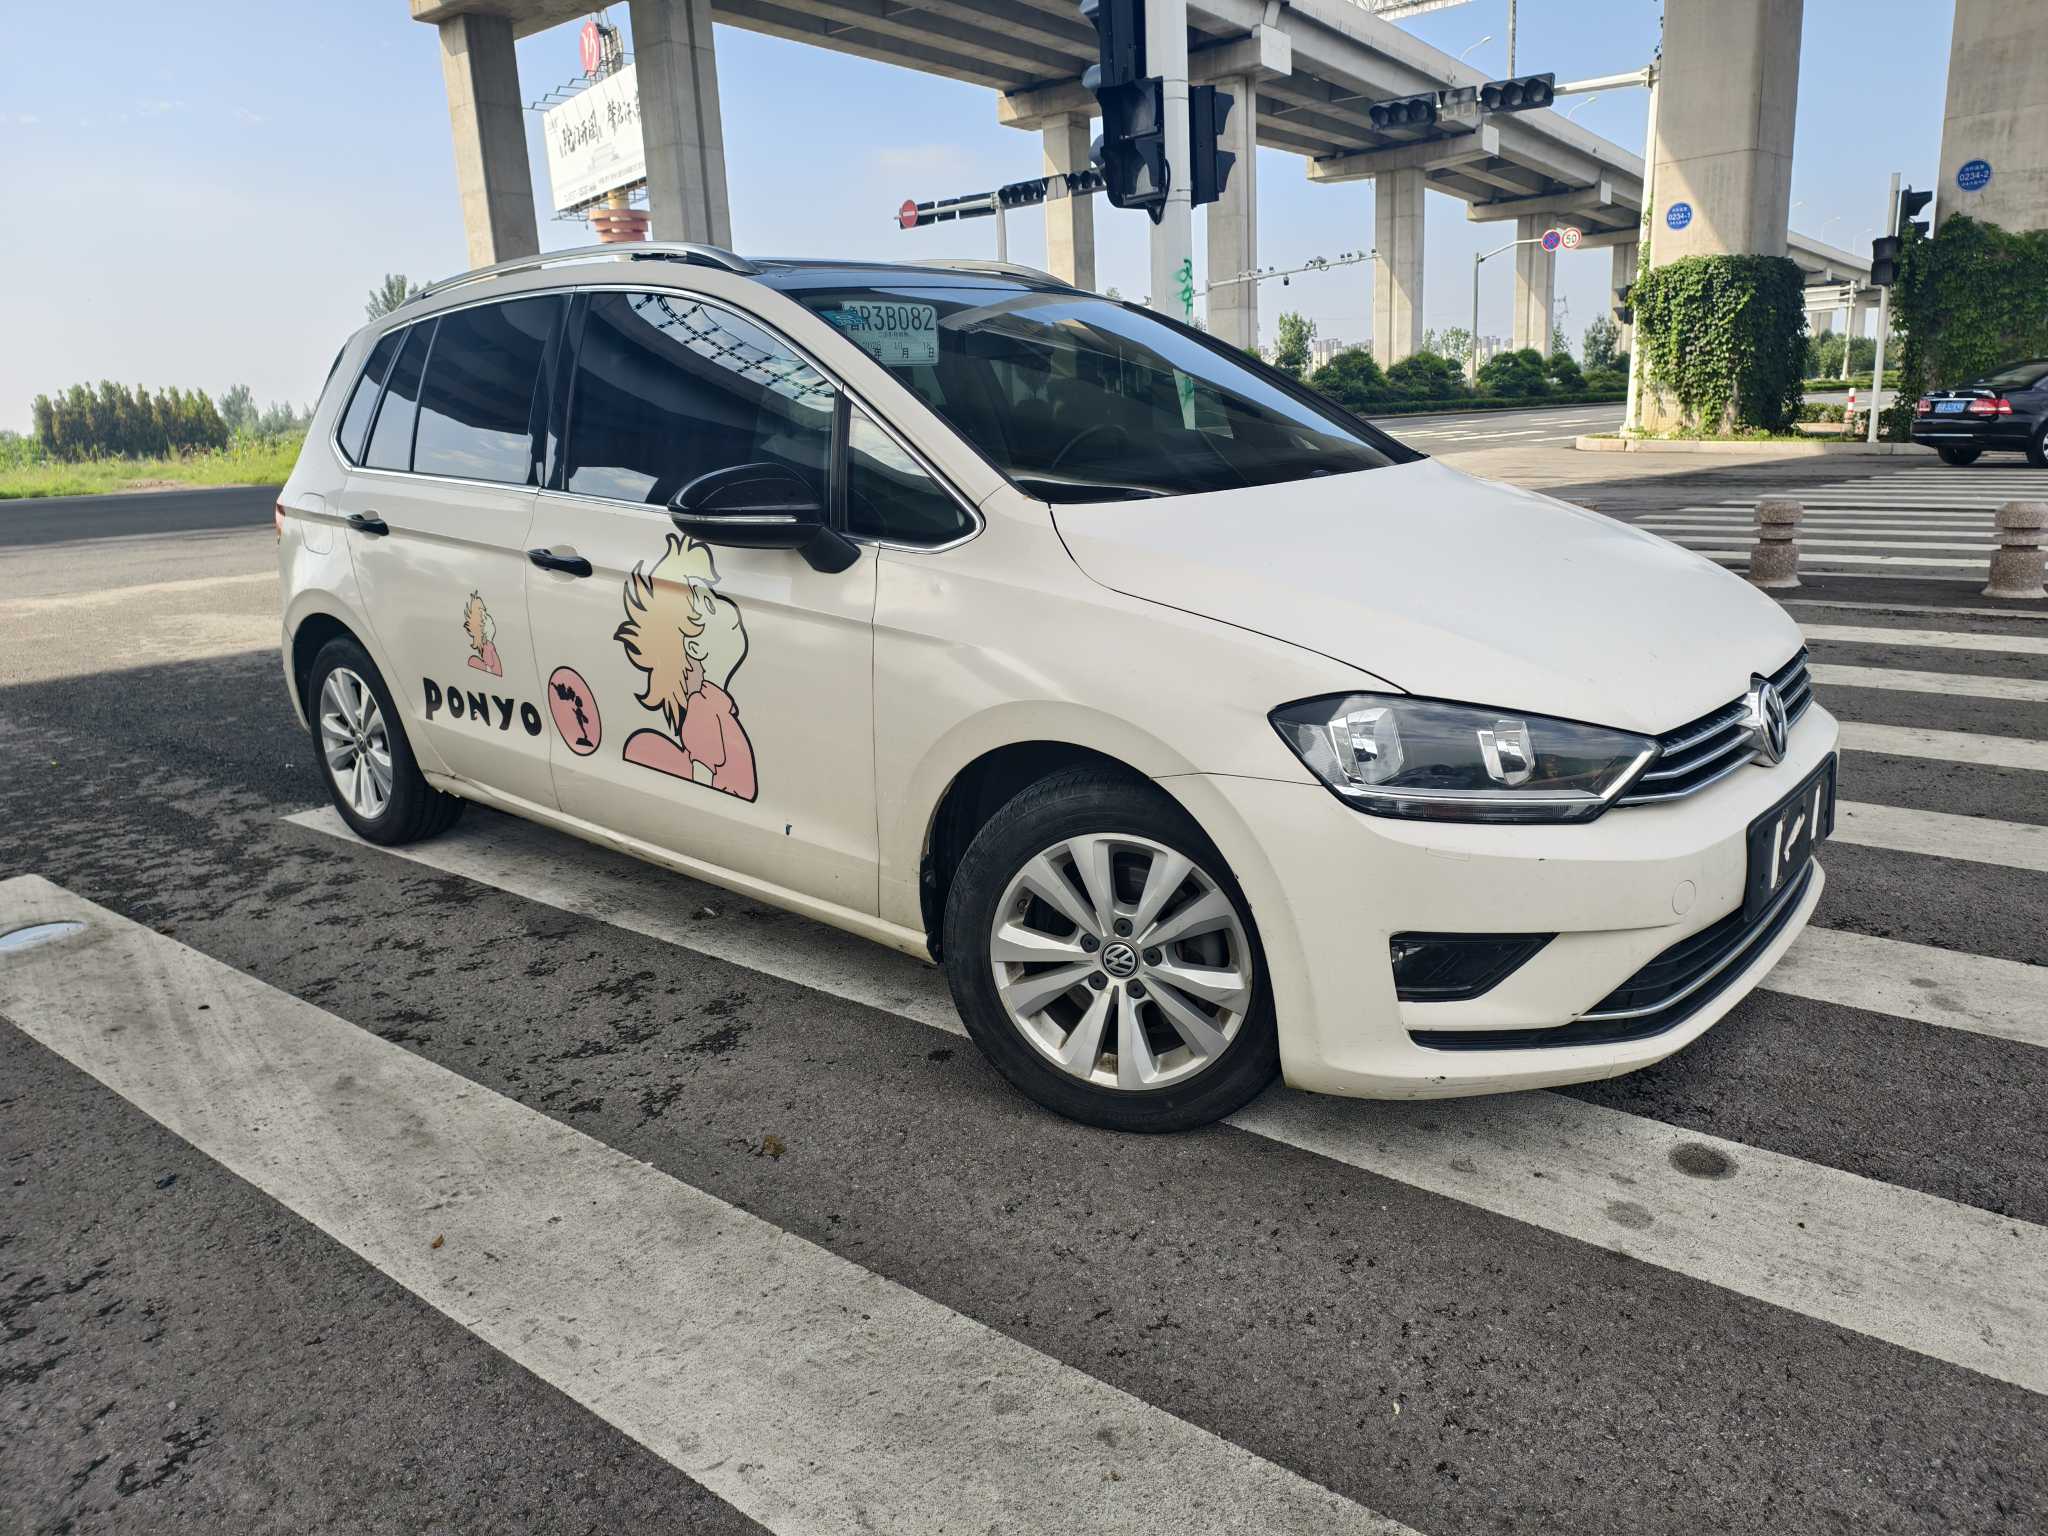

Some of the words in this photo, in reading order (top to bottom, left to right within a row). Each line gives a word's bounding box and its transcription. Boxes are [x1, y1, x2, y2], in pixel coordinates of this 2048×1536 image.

[1959, 170, 1989, 181] 0234-2
[1668, 212, 1690, 221] 0234-1
[1566, 234, 1577, 245] 50
[423, 677, 543, 737] PONYO
